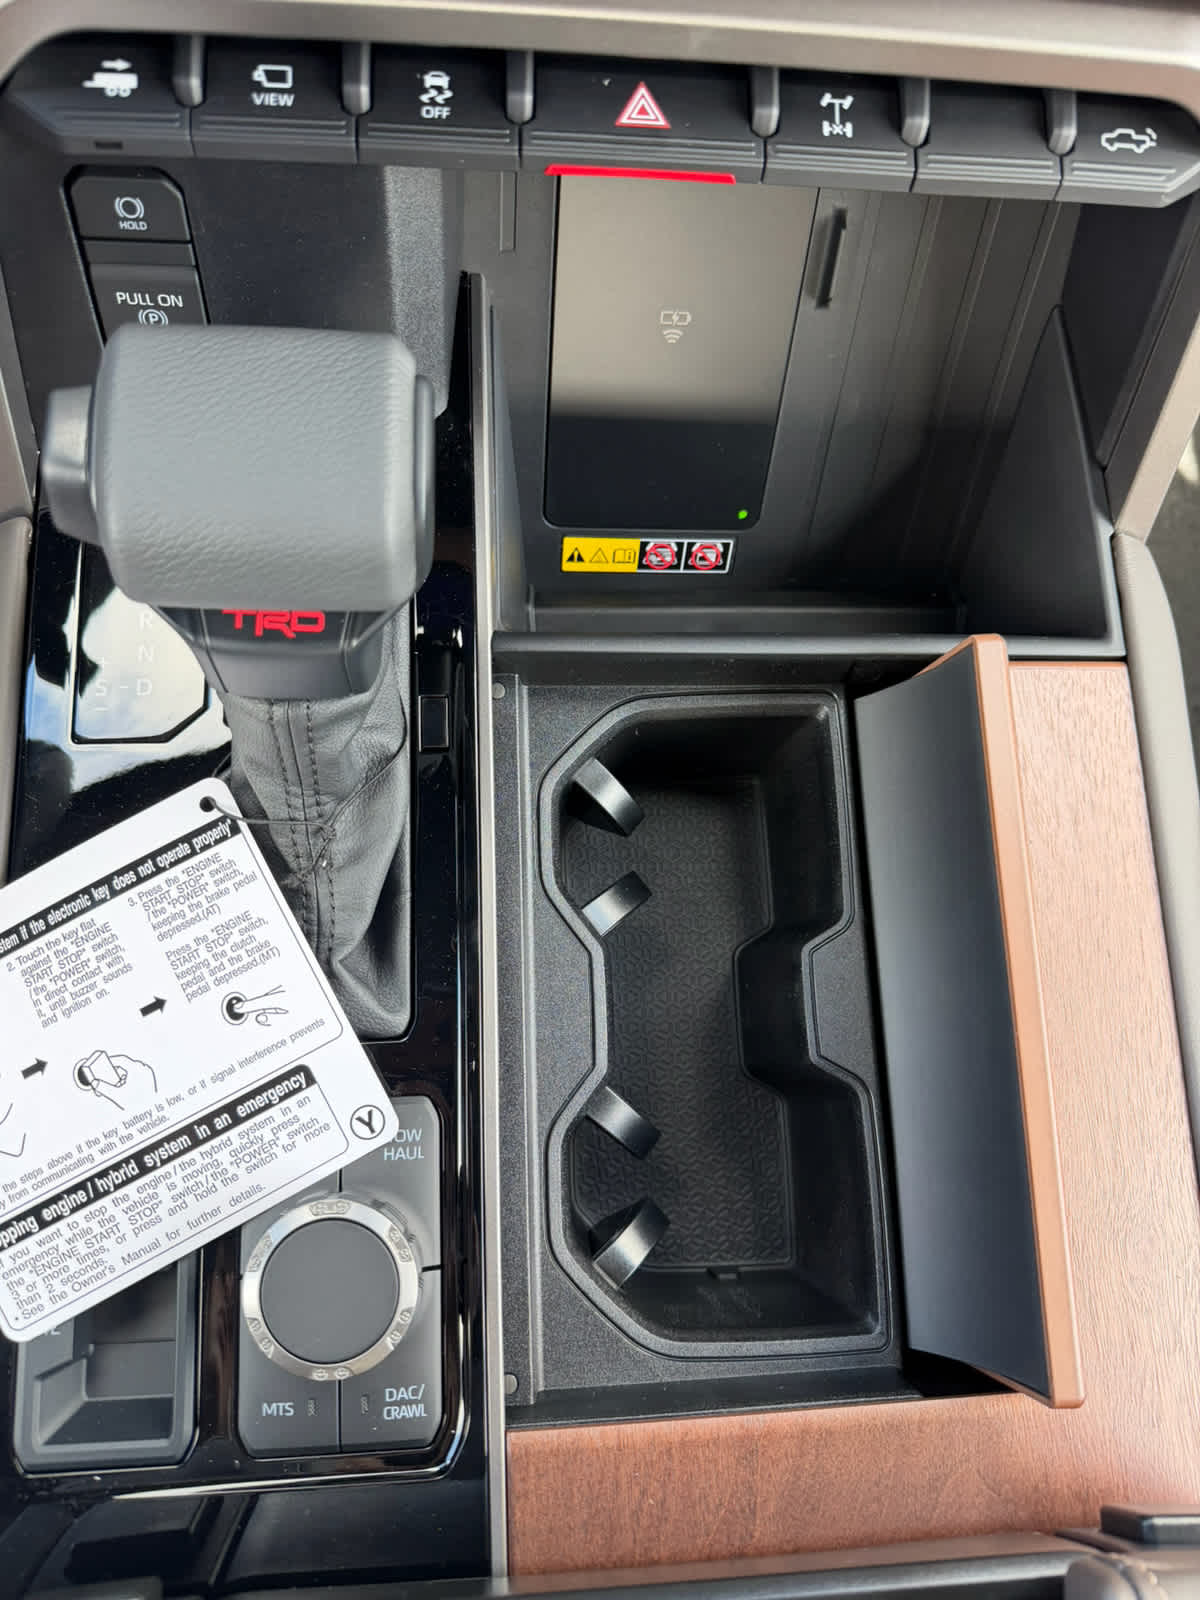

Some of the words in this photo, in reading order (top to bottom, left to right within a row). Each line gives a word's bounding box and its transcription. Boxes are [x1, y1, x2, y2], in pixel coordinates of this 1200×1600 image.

[252, 92, 295, 107] VIEW
[420, 106, 451, 119] OFF
[119, 221, 148, 231] HOLD
[116, 292, 155, 306] PULL
[157, 294, 184, 307] ON
[222, 608, 325, 639] TRD
[19, 924, 28, 940] if
[29, 919, 46, 934] the
[47, 894, 91, 924] electronic
[91, 884, 110, 900] key
[112, 871, 136, 889] does
[137, 859, 155, 877] not
[156, 843, 190, 867] operate
[127, 897, 137, 907] 3.
[137, 884, 163, 901] Press
[164, 875, 180, 887] the
[142, 889, 171, 911] START
[208, 859, 236, 877] switch
[151, 909, 186, 930] keeping
[187, 900, 203, 912] the
[204, 886, 230, 903] brake
[232, 871, 257, 891] pedal
[15, 946, 44, 965] Touch
[45, 937, 61, 950] the
[61, 927, 78, 941] key
[79, 918, 96, 932] flat
[165, 943, 191, 960] Press
[193, 934, 209, 946] the
[174, 958, 210, 980] keeping
[211, 949, 227, 961] the
[230, 934, 256, 952] clutch
[21, 954, 51, 976] against
[53, 946, 68, 959] the
[24, 965, 52, 987] START
[91, 932, 118, 952] switch
[170, 948, 200, 970] START
[180, 971, 205, 992] pedal
[207, 960, 226, 976] and
[227, 954, 243, 966] the
[244, 940, 270, 957] brake
[31, 998, 42, 1008] in
[44, 983, 68, 1001] direct
[71, 965, 102, 987] contact
[105, 955, 124, 968] with
[49, 995, 67, 1011] until
[69, 981, 97, 1000] buzzer
[102, 963, 132, 983] sounds
[185, 981, 210, 1002] pedal
[41, 1012, 58, 1027] and
[60, 997, 91, 1018] ignition
[1, 1181, 17, 1192] the
[19, 1167, 43, 1184] steps
[47, 1151, 73, 1169] above
[76, 1143, 83, 1153] if
[85, 1137, 100, 1149] the
[102, 1127, 118, 1139] key
[122, 1109, 152, 1129] battery
[154, 1103, 164, 1112] is
[187, 1085, 197, 1095] or
[199, 1079, 206, 1088] if
[210, 1064, 235, 1083] signal
[238, 1039, 286, 1068] interference
[289, 1018, 325, 1042] prevents
[355, 1109, 382, 1134] Y
[394, 1128, 422, 1143] OW
[0, 1216, 39, 1247] pping
[144, 1135, 191, 1166] system
[194, 1124, 211, 1139] in
[214, 1113, 232, 1129] an
[237, 1072, 305, 1116] emergency
[7, 1187, 29, 1202] from
[31, 1153, 94, 1190] communicating
[98, 1142, 117, 1154] with
[118, 1132, 133, 1144] the
[384, 1146, 425, 1161] HAUL
[9, 1247, 30, 1264] you
[35, 1228, 62, 1247] want
[66, 1220, 79, 1231] to
[84, 1205, 107, 1222] stop
[111, 1193, 129, 1207] the
[199, 1136, 232, 1160] hybrid
[237, 1115, 275, 1139] system
[279, 1106, 292, 1117] in
[296, 1095, 311, 1108] an
[1, 1244, 59, 1279] emergency
[64, 1226, 93, 1245] while
[97, 1214, 116, 1228] the
[121, 1188, 158, 1214] vehicle
[165, 1181, 177, 1192] is
[229, 1134, 263, 1157] quickly
[270, 1114, 300, 1138] press
[6, 1277, 24, 1291] the
[84, 1222, 120, 1248] START
[286, 1117, 319, 1139] switch
[11, 1289, 20, 1300] 3
[25, 1280, 37, 1292] or
[42, 1264, 69, 1284] more
[115, 1232, 127, 1244] or
[132, 1215, 162, 1237] press
[167, 1198, 188, 1216] and
[193, 1182, 218, 1201] hold
[220, 1173, 239, 1187] the
[245, 1152, 277, 1174] switch
[281, 1140, 296, 1152] for
[303, 1122, 330, 1142] more
[21, 1303, 44, 1319] See
[48, 1290, 67, 1304] the
[71, 1264, 115, 1292] Owner's
[121, 1238, 160, 1264] Manual
[165, 1229, 180, 1241] for
[186, 1206, 221, 1229] further
[16, 1292, 41, 1309] than
[45, 1283, 55, 1294] 2
[385, 1384, 425, 1402] DAC/
[261, 1402, 294, 1417] MTS
[383, 1404, 428, 1420] CRAWL
